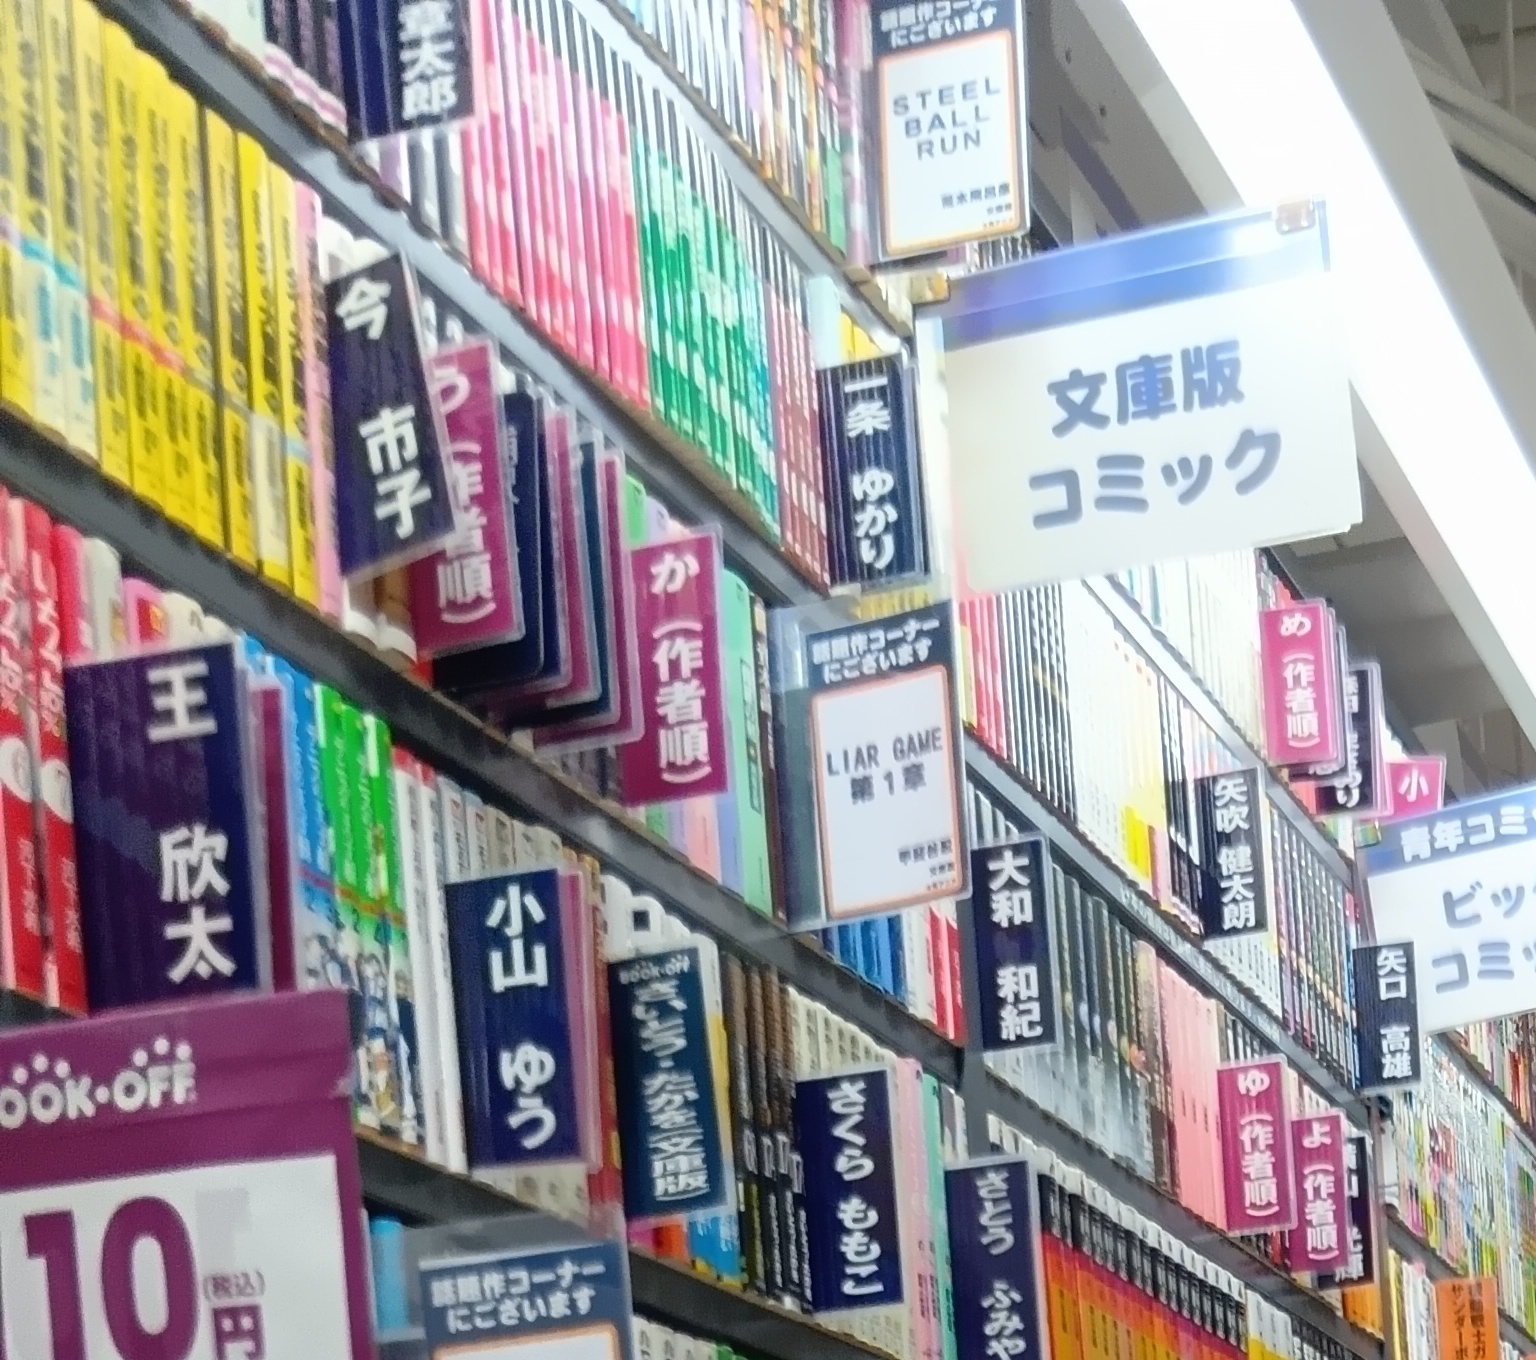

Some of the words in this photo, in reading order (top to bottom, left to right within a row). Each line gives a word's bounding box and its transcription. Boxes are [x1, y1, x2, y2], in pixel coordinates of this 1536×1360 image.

[893, 77, 1001, 116] STEEL
[905, 105, 990, 139] BALL
[917, 129, 981, 160] RUN
[1047, 340, 1245, 438] 文庫版
[1028, 428, 1282, 531] コミック
[650, 553, 712, 786] か（作者順）
[826, 745, 879, 777] LIAR
[893, 727, 943, 762] GAME
[1237, 1070, 1280, 1217] ゆ（作者順）
[1303, 1122, 1339, 1261] よ（作者順）
